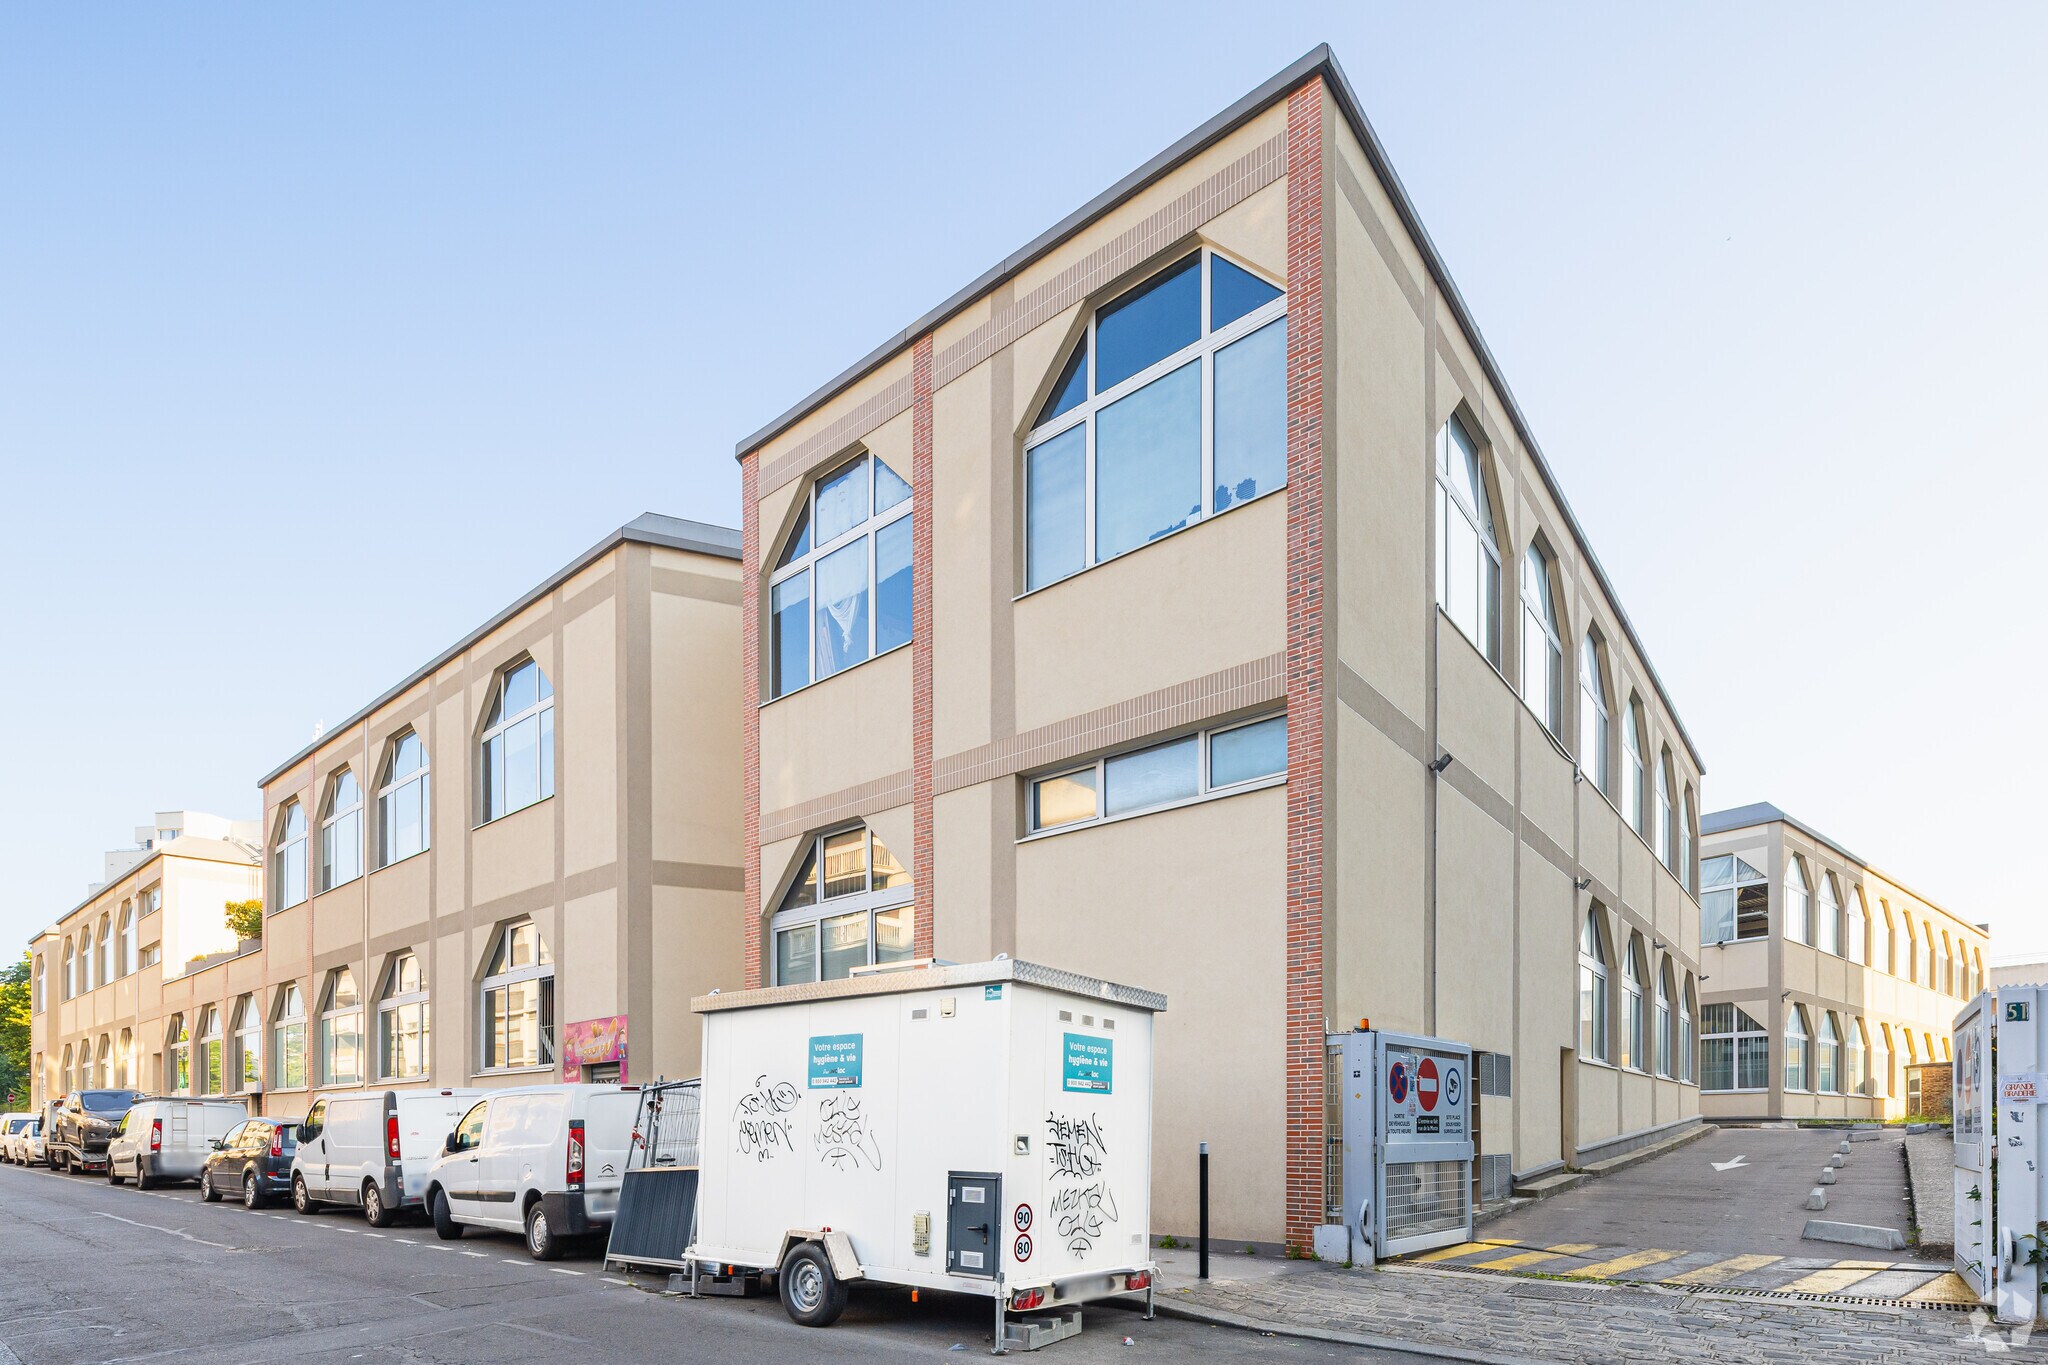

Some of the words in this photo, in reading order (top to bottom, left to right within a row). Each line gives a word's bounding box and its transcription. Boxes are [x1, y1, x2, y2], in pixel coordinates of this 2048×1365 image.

[2008, 1004, 2026, 1020] 51
[833, 1043, 856, 1052] espace
[1070, 1042, 1086, 1051] Votre
[1087, 1046, 1107, 1055] espace
[813, 1054, 838, 1065] hygiène
[847, 1053, 856, 1062] vie
[1069, 1054, 1092, 1067] hygiène
[1100, 1058, 1108, 1067] vie
[1018, 1212, 1030, 1224] 90
[1017, 1242, 1030, 1255] 80
